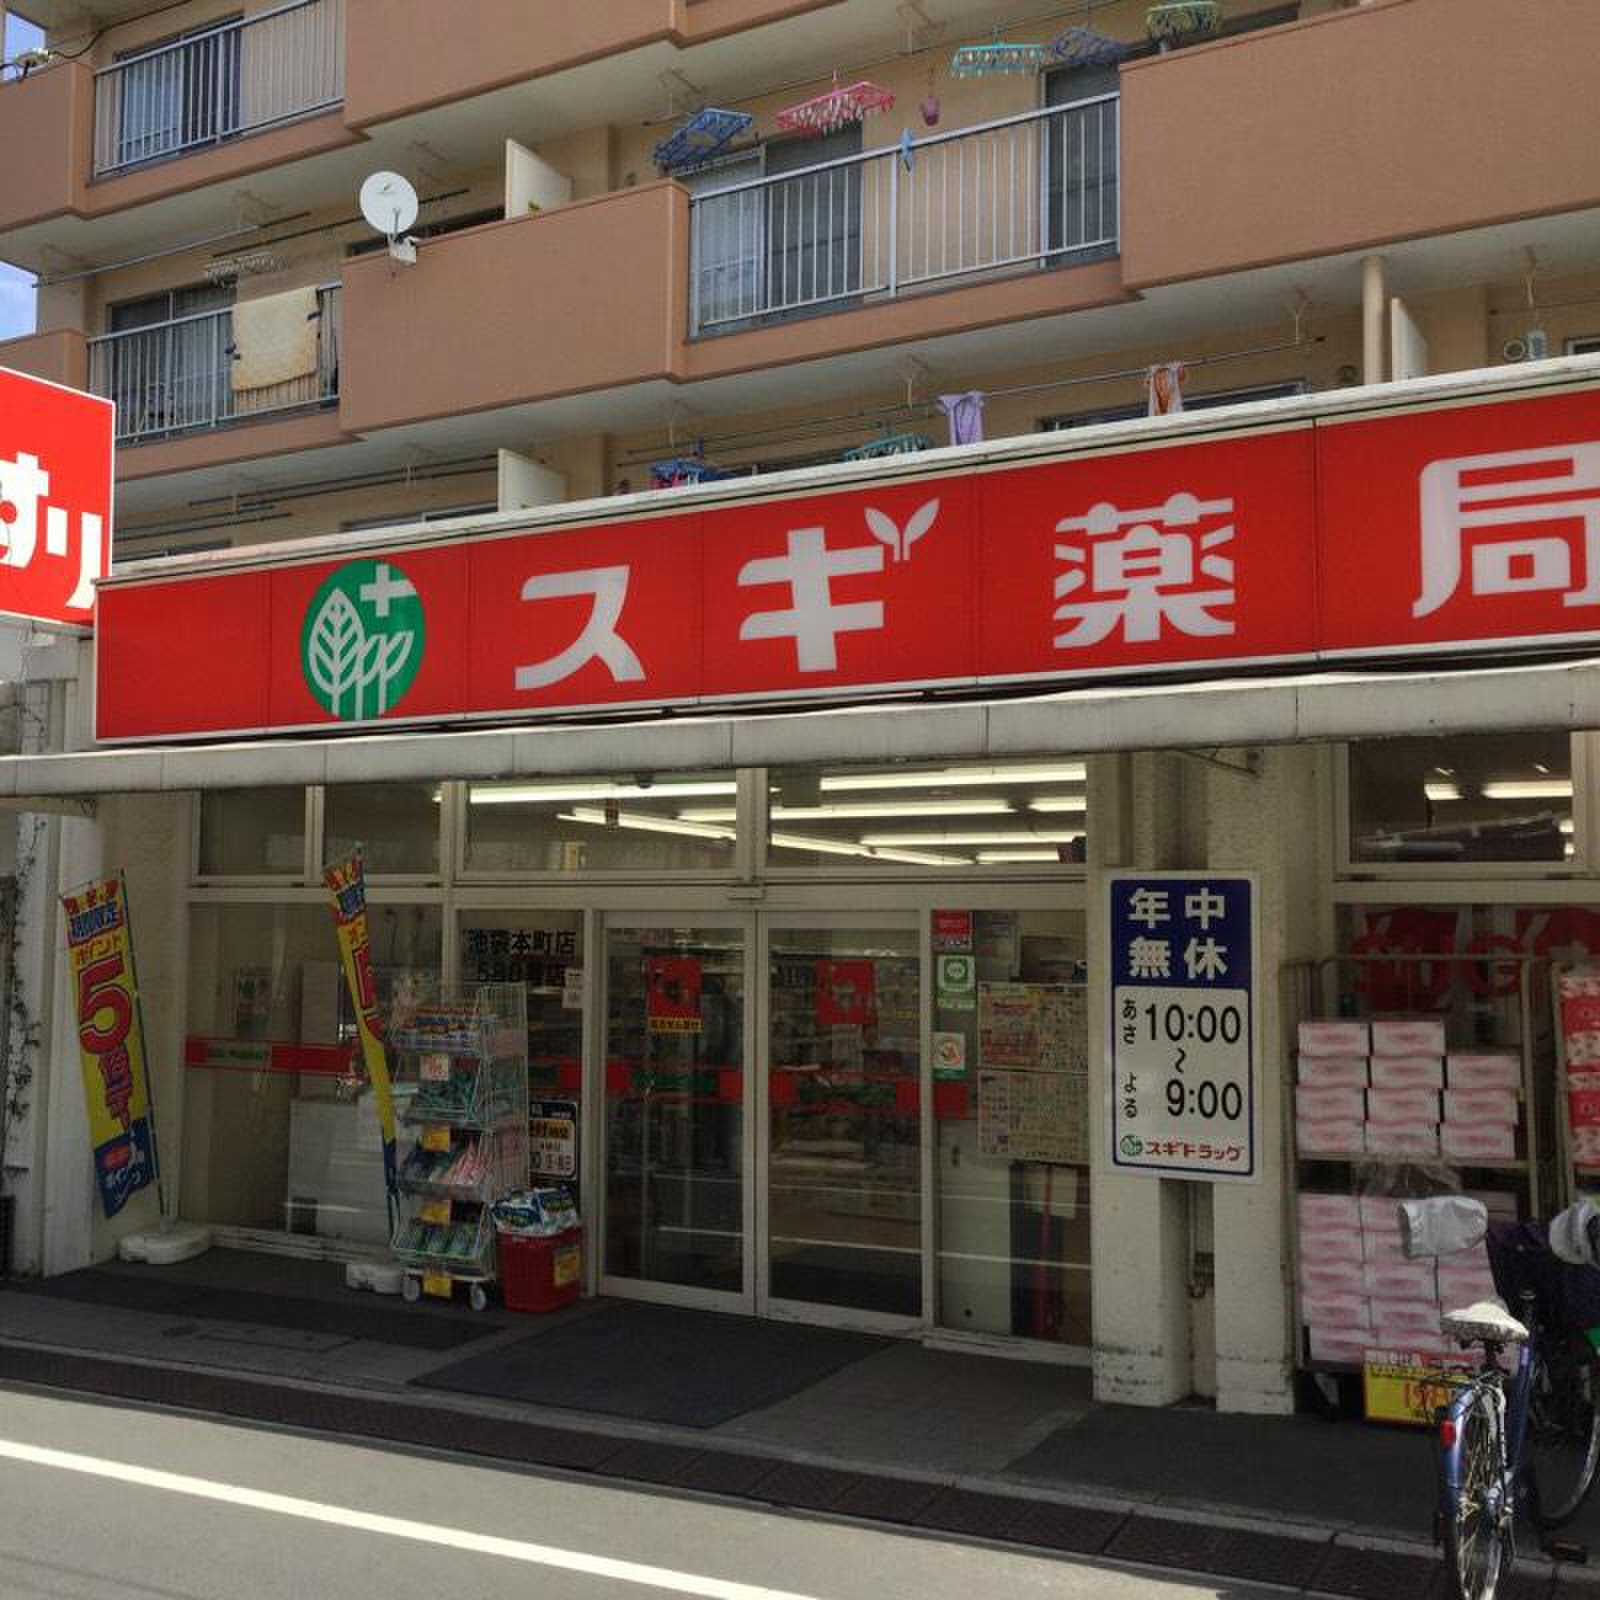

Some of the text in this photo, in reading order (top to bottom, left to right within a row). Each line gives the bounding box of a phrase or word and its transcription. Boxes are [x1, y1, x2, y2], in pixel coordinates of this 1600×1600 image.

[514, 440, 1600, 690] スギ薬局
[79, 951, 132, 1054] 5
[1123, 1000, 1136, 1044] あさ
[1145, 1003, 1241, 1044] 10:00
[1124, 1072, 1137, 1118] よる
[1166, 1079, 1242, 1121] 9:00
[1145, 1139, 1245, 1162] スギドラッグ
